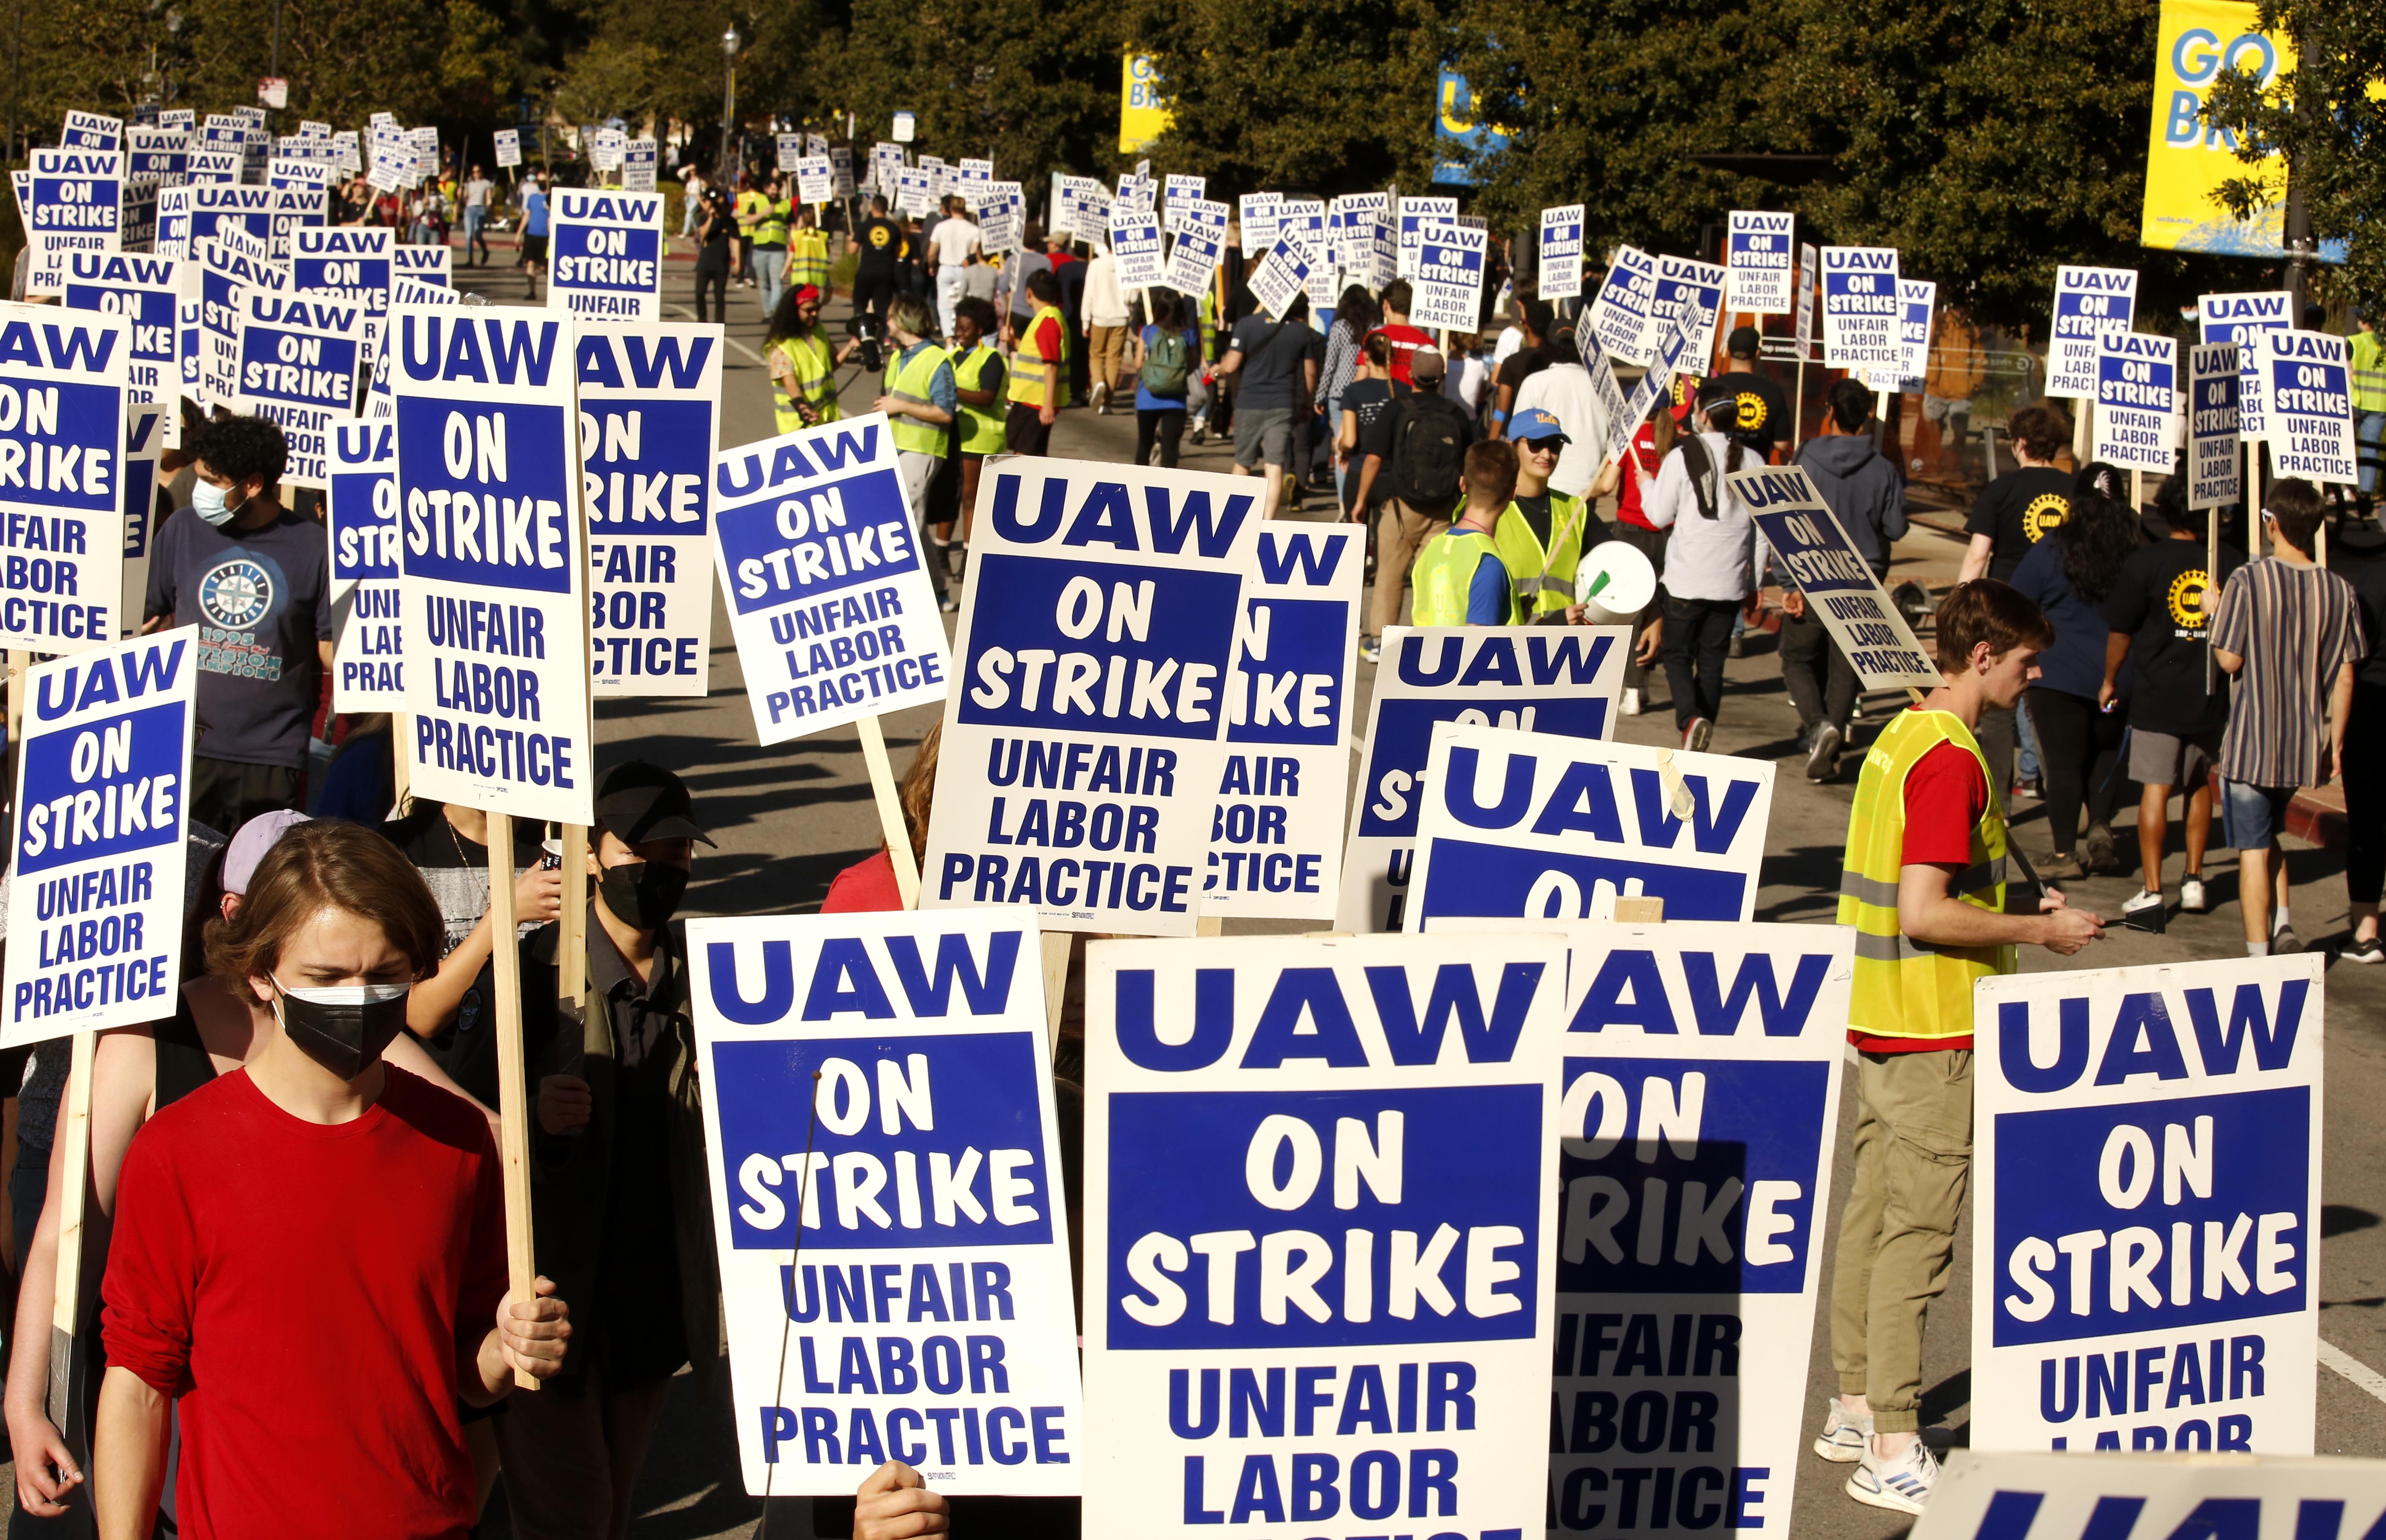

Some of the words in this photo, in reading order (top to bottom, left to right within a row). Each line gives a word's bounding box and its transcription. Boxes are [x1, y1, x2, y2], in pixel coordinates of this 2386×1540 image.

[2172, 28, 2278, 90] GO
[72, 115, 118, 132] UAW
[211, 117, 245, 128] UAW
[80, 134, 102, 147] ON
[136, 136, 187, 150] UAW
[626, 142, 655, 150] UAW
[38, 155, 117, 174] UAW
[148, 155, 171, 170] ON
[275, 163, 324, 179] UAW
[59, 182, 92, 203] ON
[1170, 177, 1201, 187] UAW
[197, 189, 269, 207] UAW
[562, 195, 658, 222] UAW
[1193, 201, 1226, 213] UAW
[1245, 195, 1278, 204] UAW
[1280, 204, 1320, 214] UAW
[1343, 197, 1384, 209] UAW
[1405, 201, 1453, 213] UAW
[35, 204, 115, 227] STRIKE
[1113, 215, 1153, 227] UAW
[1546, 209, 1581, 224] UAW
[1733, 216, 1789, 230] UAW
[169, 219, 186, 237] ON
[1126, 229, 1144, 240] ON
[1183, 220, 1220, 241] UAW
[1425, 227, 1482, 248] UAW
[1553, 226, 1570, 240] ON
[299, 233, 386, 252] UAW
[587, 229, 626, 255] ON
[1116, 239, 1158, 253] STRIKE
[1189, 238, 1207, 252] ON
[1285, 229, 1317, 265] UAW
[1543, 239, 1579, 257] STRIKE
[1749, 236, 1772, 251] ON
[73, 253, 174, 284] UAW
[1439, 249, 1464, 266] ON
[1547, 260, 1574, 271] UNFAIR
[1732, 251, 1788, 268] STRIKE
[1826, 252, 1893, 269] UAW
[323, 261, 360, 285] ON
[557, 255, 654, 286] STRIKE
[1420, 263, 1479, 284] STRIKE
[1548, 271, 1572, 281] LABOR
[1662, 260, 1725, 285] UAW
[1739, 271, 1780, 282] UNFAIR
[2065, 271, 2131, 291] UAW
[1426, 285, 1469, 300] UNFAIR
[1542, 281, 1577, 294] PRACTICE
[1741, 284, 1778, 294] LABOR
[1847, 275, 1875, 293] ON
[99, 290, 141, 321] ON
[252, 296, 356, 332] UAW
[568, 294, 640, 315] UNFAIR
[1427, 299, 1466, 312] LABOR
[1731, 296, 1786, 308] PRACTICE
[1828, 294, 1895, 313] STRIKE
[2079, 296, 2108, 316] ON
[2207, 297, 2284, 318] UAW
[1416, 309, 1474, 327] PRACTICE
[1603, 307, 1644, 333] UNFAIR
[1838, 319, 1889, 331] UNFAIR
[1600, 320, 1637, 344] LABOR
[1842, 333, 1886, 346] LABOR
[278, 335, 321, 366] ON
[402, 315, 559, 387] UAW
[1831, 348, 1898, 361] PRACTICE
[2104, 334, 2171, 358] UAW
[2272, 335, 2341, 361] UAW
[2122, 360, 2150, 383] ON
[2194, 348, 2238, 375] UAW
[244, 361, 350, 401] STRIKE
[2297, 366, 2325, 388] ON
[2101, 380, 2171, 408] STRIKE
[2208, 381, 2226, 405] ON
[2277, 388, 2347, 415] STRIKE
[2110, 411, 2161, 430] UNFAIR
[2195, 407, 2238, 433] STRIKE
[2287, 418, 2341, 437] UNFAIR
[444, 411, 507, 484] ON
[1640, 440, 1655, 450] UA
[2113, 428, 2158, 446] LABOR
[2199, 438, 2234, 459] UNFAIR
[2292, 437, 2340, 456] LABOR
[717, 424, 878, 498] UAW
[2100, 444, 2169, 465] PRACTICE
[2280, 455, 2353, 475] PRACTICE
[2201, 459, 2232, 479] LABOR
[1734, 473, 1812, 508] UAW
[2194, 478, 2238, 500] PRACTICE
[776, 486, 847, 540] ON
[992, 474, 1254, 558] UAW
[2039, 515, 2061, 527] UAW
[407, 487, 564, 570] STRIKE
[1785, 513, 1825, 545] ON
[738, 521, 911, 599] STRIKE
[1788, 549, 1866, 583] STRIKE
[211, 565, 266, 589] SEATTLE
[206, 597, 263, 624] MARINERS
[770, 587, 904, 645] UNFAIR
[1056, 576, 1156, 643] ON
[1824, 596, 1886, 620] UNFAIR
[202, 627, 255, 646] 1995
[427, 594, 545, 660] UNFAIR
[1846, 623, 1902, 646] LABOR
[199, 647, 282, 669] VISION
[786, 624, 905, 681] LABOR
[1398, 636, 1615, 686] UAW
[1851, 650, 1931, 674] PRACTICE
[37, 639, 187, 721] UAW
[198, 659, 280, 681] AMPIONS
[435, 657, 540, 722] LABOR
[766, 652, 944, 724] PRACTICE
[970, 646, 1218, 724] STRIKE
[70, 719, 132, 784] ON
[417, 714, 573, 789] PRACTICE
[987, 738, 1177, 797] UNFAIR
[1444, 746, 1760, 855] UAW
[23, 774, 176, 858] STRIKE
[987, 797, 1159, 854] LABOR
[37, 862, 153, 921] UNFAIR
[939, 853, 1193, 912] PRACTICE
[39, 912, 143, 969] LABOR
[15, 955, 167, 1023] PRACTICE
[706, 930, 1022, 1026] UAW
[1115, 962, 1546, 1072] UAW
[1998, 979, 2310, 1093] UAW
[816, 1052, 934, 1136] ON
[1561, 1071, 1706, 1161] ON
[1245, 1110, 1404, 1211] ON
[2099, 1115, 2214, 1209] ON
[738, 1145, 1039, 1231] STRIKE
[1121, 1222, 1524, 1326] STRIKE
[2004, 1212, 2297, 1322] STRIKE
[779, 1261, 1015, 1323] UNFAIR
[799, 1335, 1010, 1395] LABOR
[2040, 1334, 2265, 1423] UNFAIR
[1168, 1361, 1476, 1440] UNFAIR
[760, 1406, 1070, 1465] PRACTICE
[1183, 1448, 1459, 1524] LABOR
